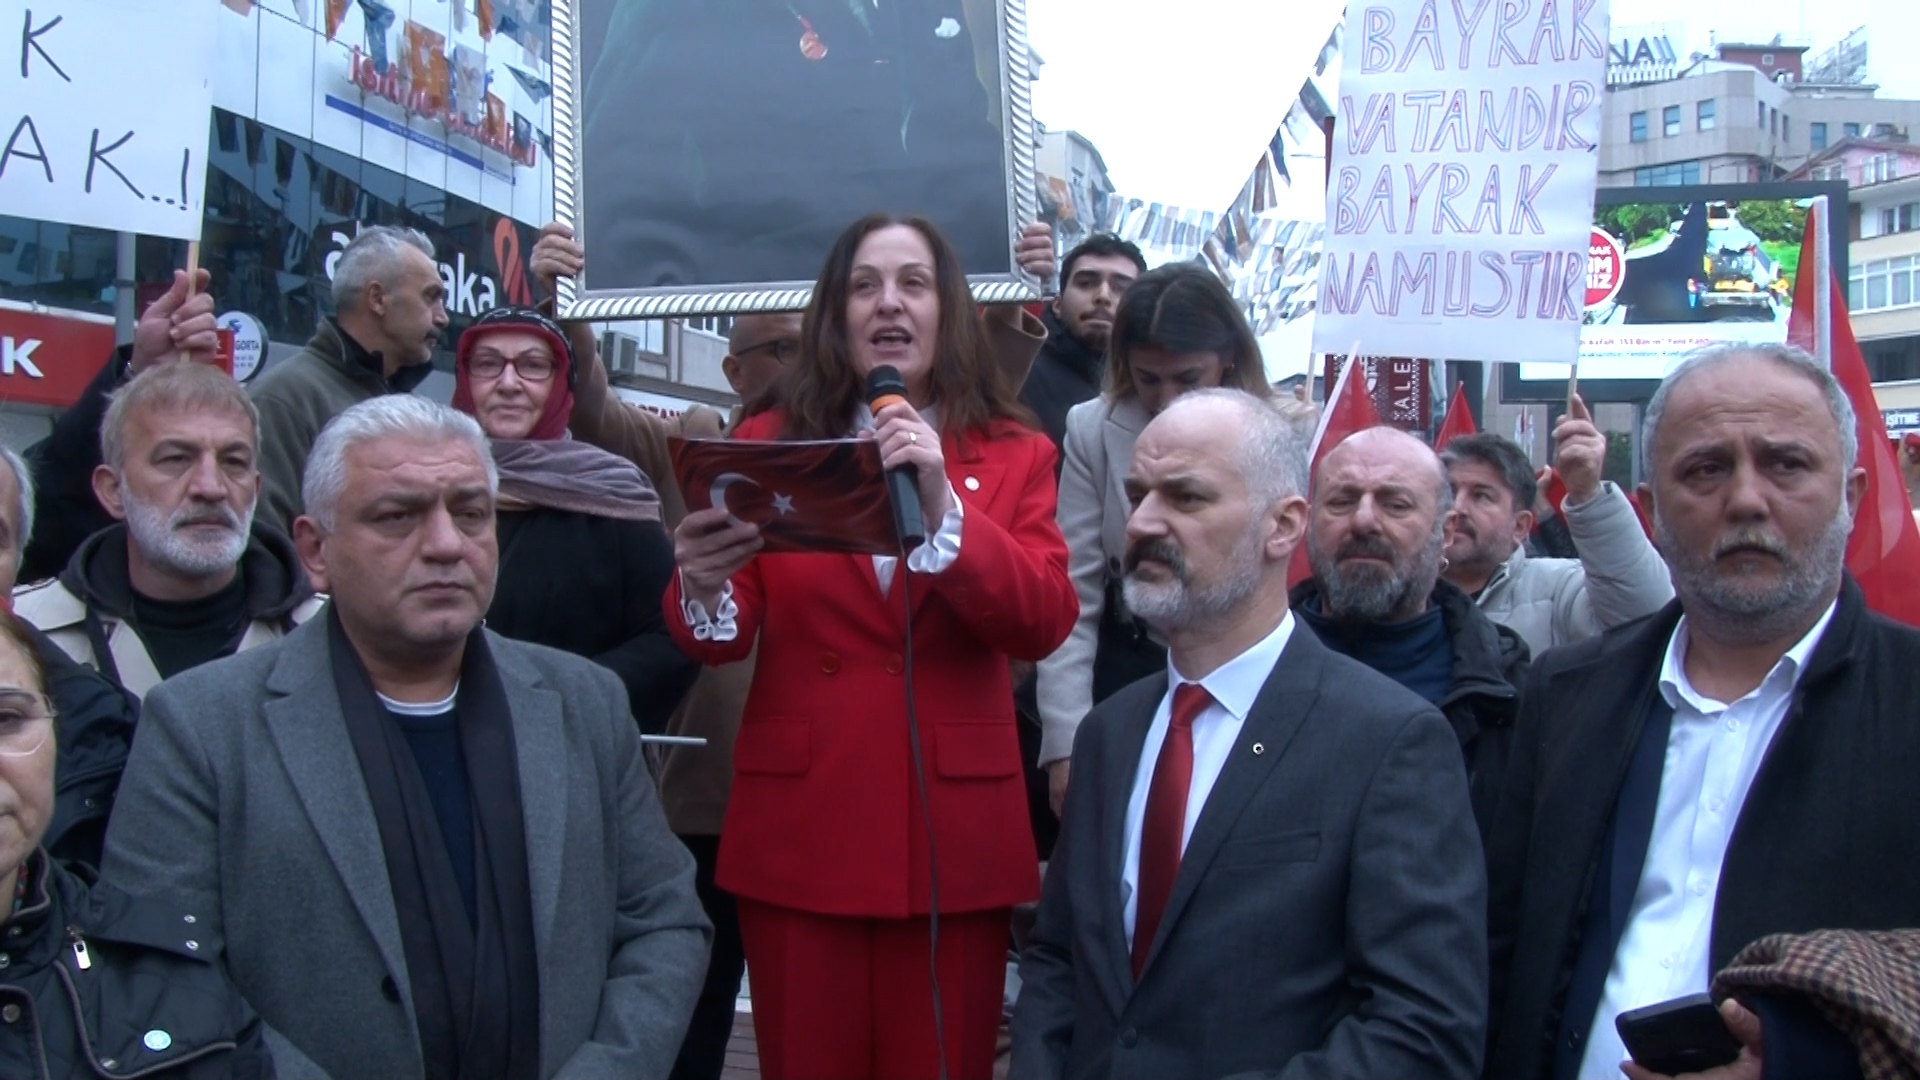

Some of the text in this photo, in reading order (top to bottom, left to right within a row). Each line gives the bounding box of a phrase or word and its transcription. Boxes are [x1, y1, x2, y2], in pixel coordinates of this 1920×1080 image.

[1360, 0, 1604, 74] BAYRAK
[1334, 162, 1559, 235] BAYRAK
[1321, 250, 1586, 321] NAMUSTUR
[1, 336, 44, 378] K
